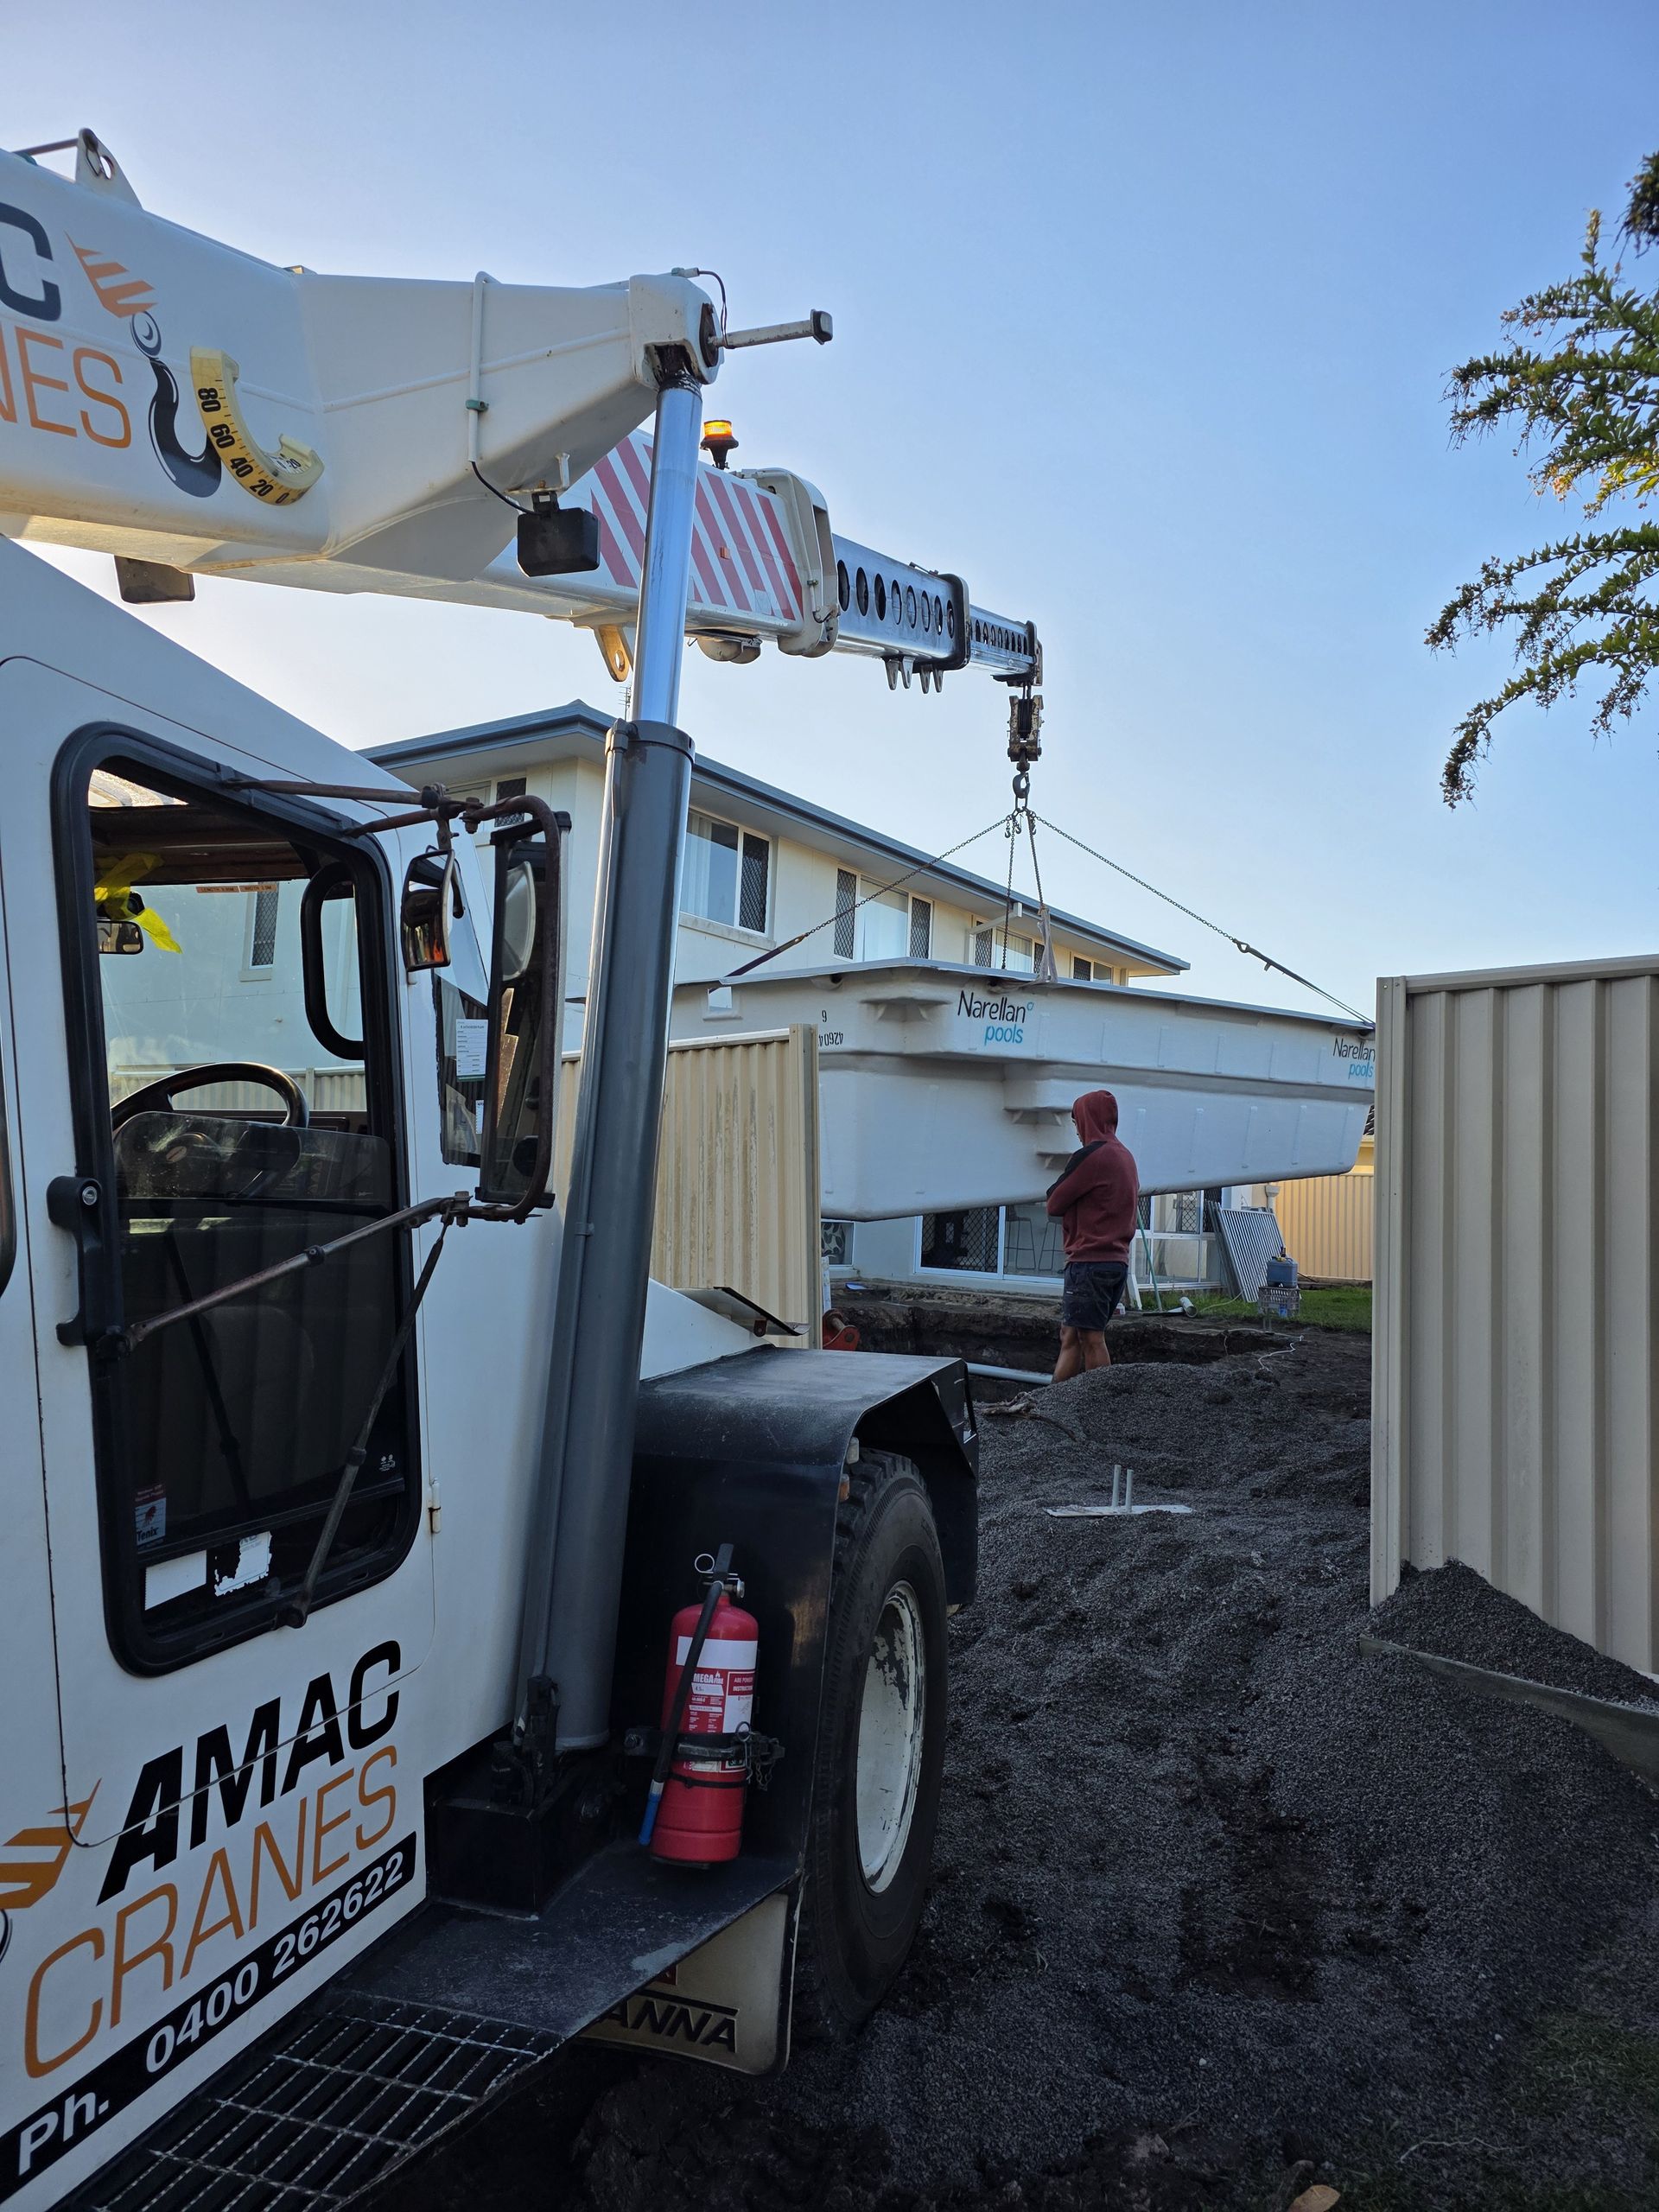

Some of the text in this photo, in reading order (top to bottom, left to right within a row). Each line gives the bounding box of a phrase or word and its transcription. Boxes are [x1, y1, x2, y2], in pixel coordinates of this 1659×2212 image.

[198, 388, 221, 412] 80
[210, 423, 235, 449] 60
[230, 457, 253, 478] 40
[249, 479, 274, 497] 20
[957, 990, 1026, 1023] Narellan
[984, 1024, 1023, 1046] pools
[1333, 1038, 1376, 1062] Narellan
[1348, 1062, 1374, 1079] pools
[137, 1527, 159, 1542] Tenix
[97, 1641, 401, 1906] AMAC
[25, 1745, 397, 2078] CRANES
[18, 1852, 404, 2177] Ph. 0400 262622
